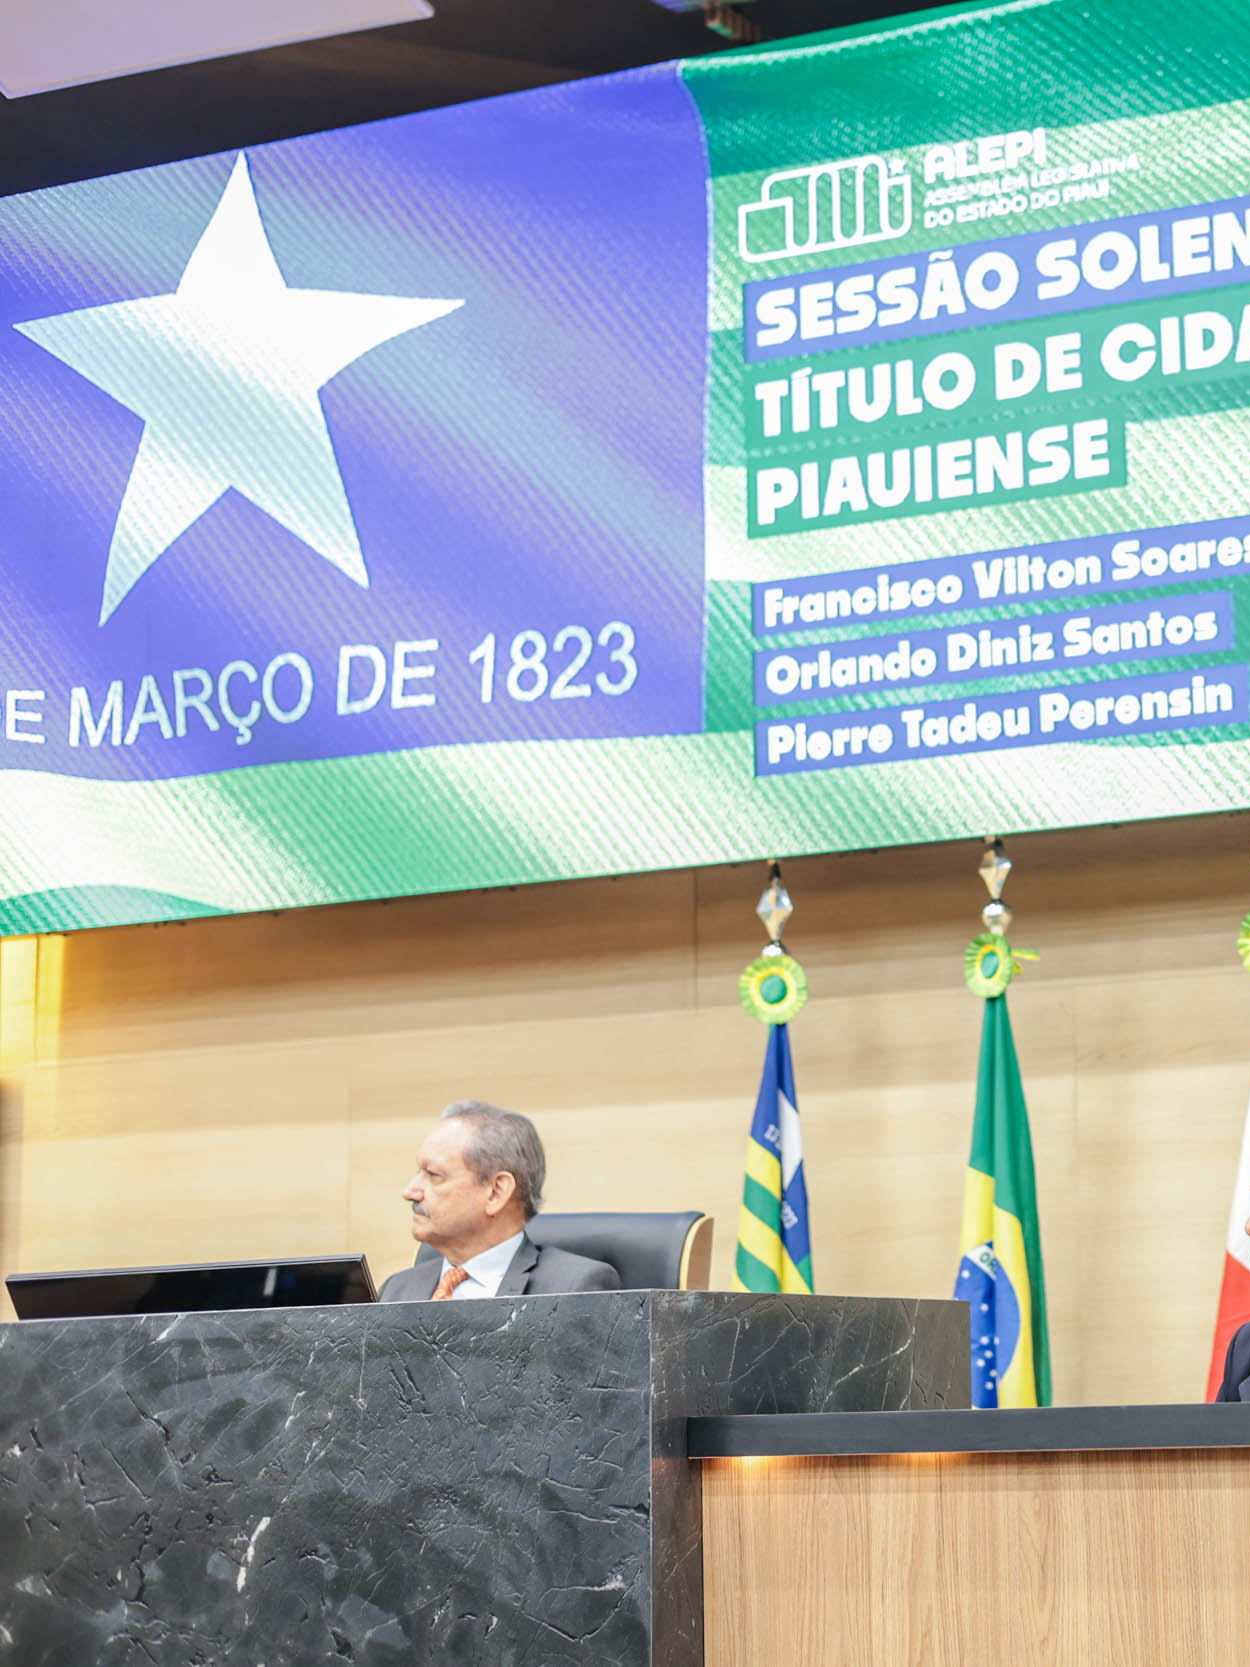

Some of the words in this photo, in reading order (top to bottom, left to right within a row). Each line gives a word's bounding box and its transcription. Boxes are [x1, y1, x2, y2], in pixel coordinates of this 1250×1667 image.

[924, 127, 1047, 185] ALEPI
[923, 209, 955, 229] DO
[956, 194, 1028, 223] ESTADO
[1030, 189, 1060, 209] DO
[755, 250, 1019, 347] SESSÃO
[755, 351, 976, 437] TÍTULO
[995, 332, 1084, 401] DE
[756, 419, 1110, 525] PIAUIENSE
[764, 574, 963, 628] Francisco
[973, 552, 1101, 600] Vilton
[0, 689, 46, 744] E
[69, 653, 313, 745] MARÇO
[336, 638, 439, 716] DE
[468, 621, 638, 704] 1823
[765, 640, 936, 695] Orlando
[947, 617, 1054, 670] Diniz
[1064, 609, 1218, 657] Santos
[767, 718, 893, 765] Pierre
[902, 698, 1030, 749] Tadeu
[1040, 676, 1233, 731] Perensin
